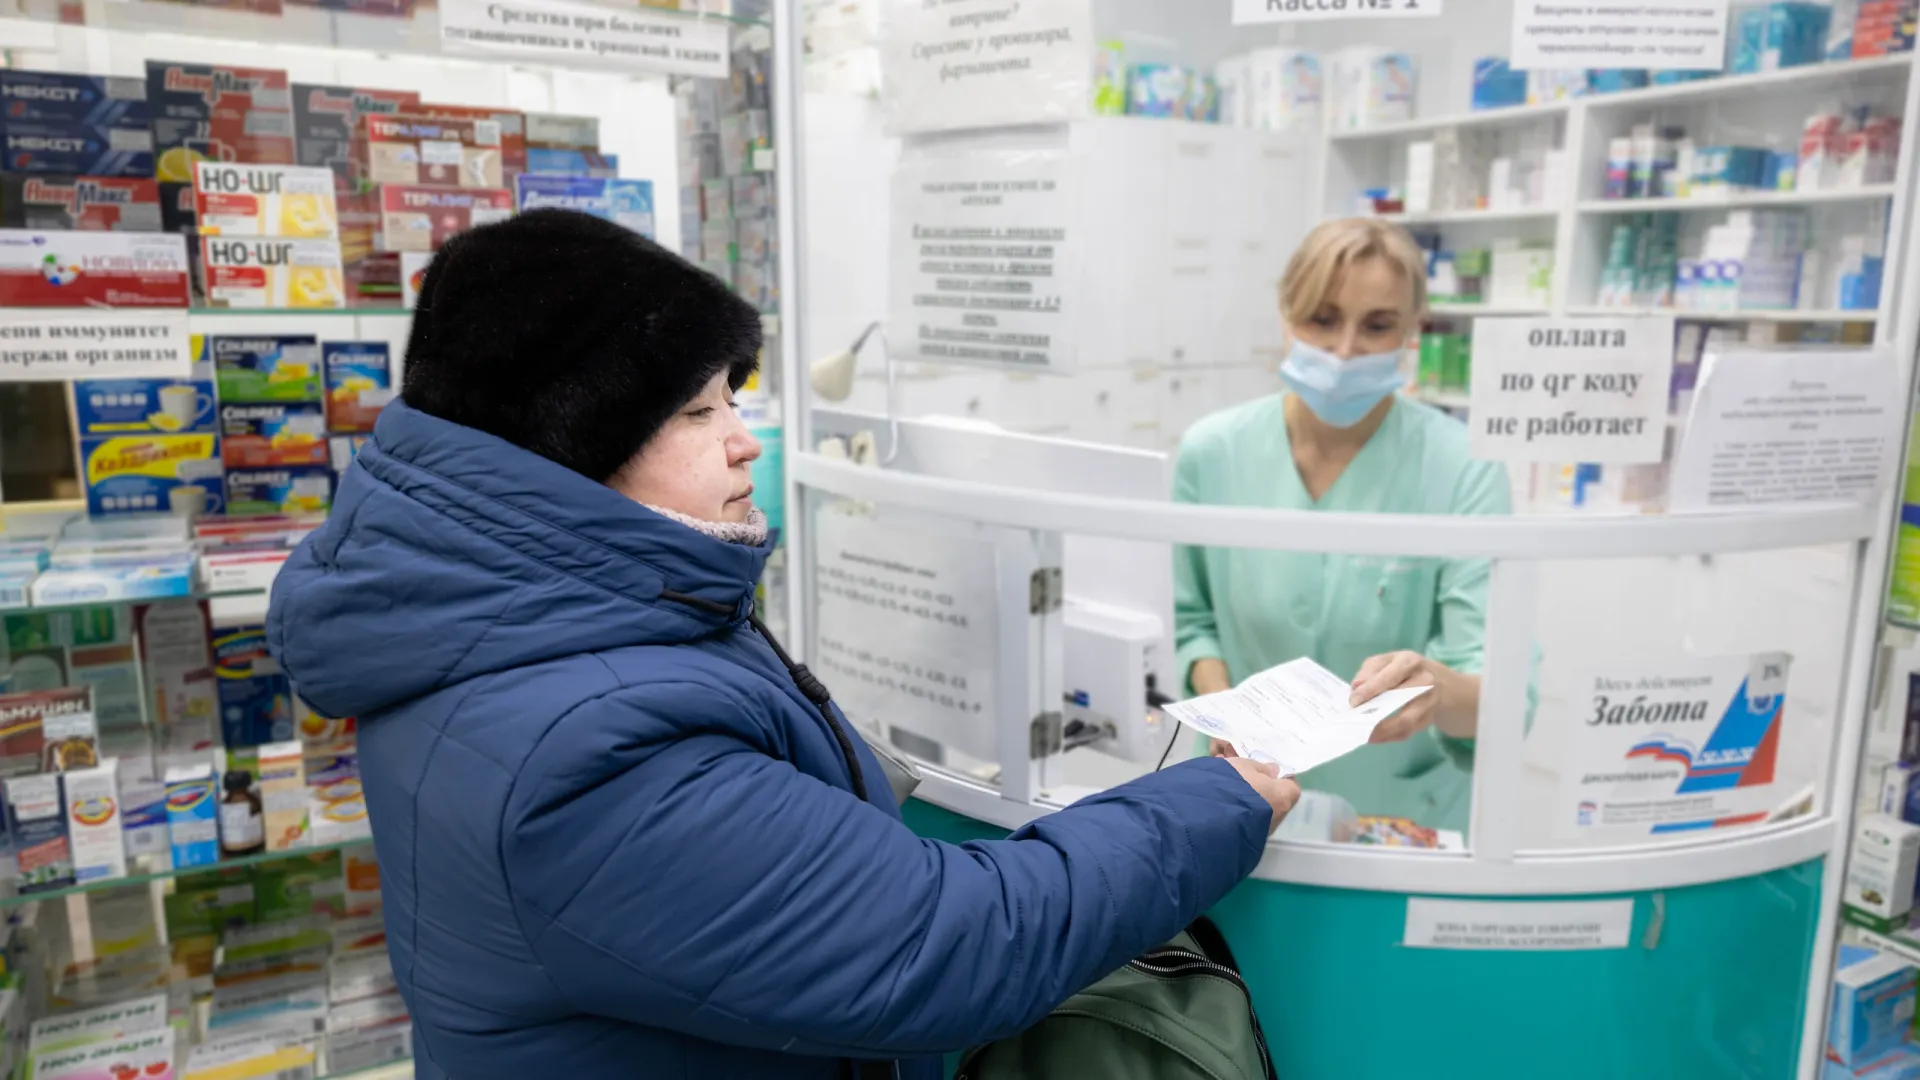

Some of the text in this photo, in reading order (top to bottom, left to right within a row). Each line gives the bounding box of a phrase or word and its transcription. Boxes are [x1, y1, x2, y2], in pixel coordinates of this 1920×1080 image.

[488, 3, 681, 38] Средства при болезнях
[675, 48, 721, 62] ткани
[2, 84, 80, 101] НЕКСТ
[8, 136, 84, 151] НЕКСТ
[49, 326, 171, 341] иммунитет
[1528, 328, 1627, 347] оплата
[75, 350, 178, 365] организм
[1501, 373, 1643, 398] по qr коду
[1486, 411, 1648, 442] не работает
[1594, 675, 1714, 692] Здесь действует
[1585, 695, 1709, 726] Забота
